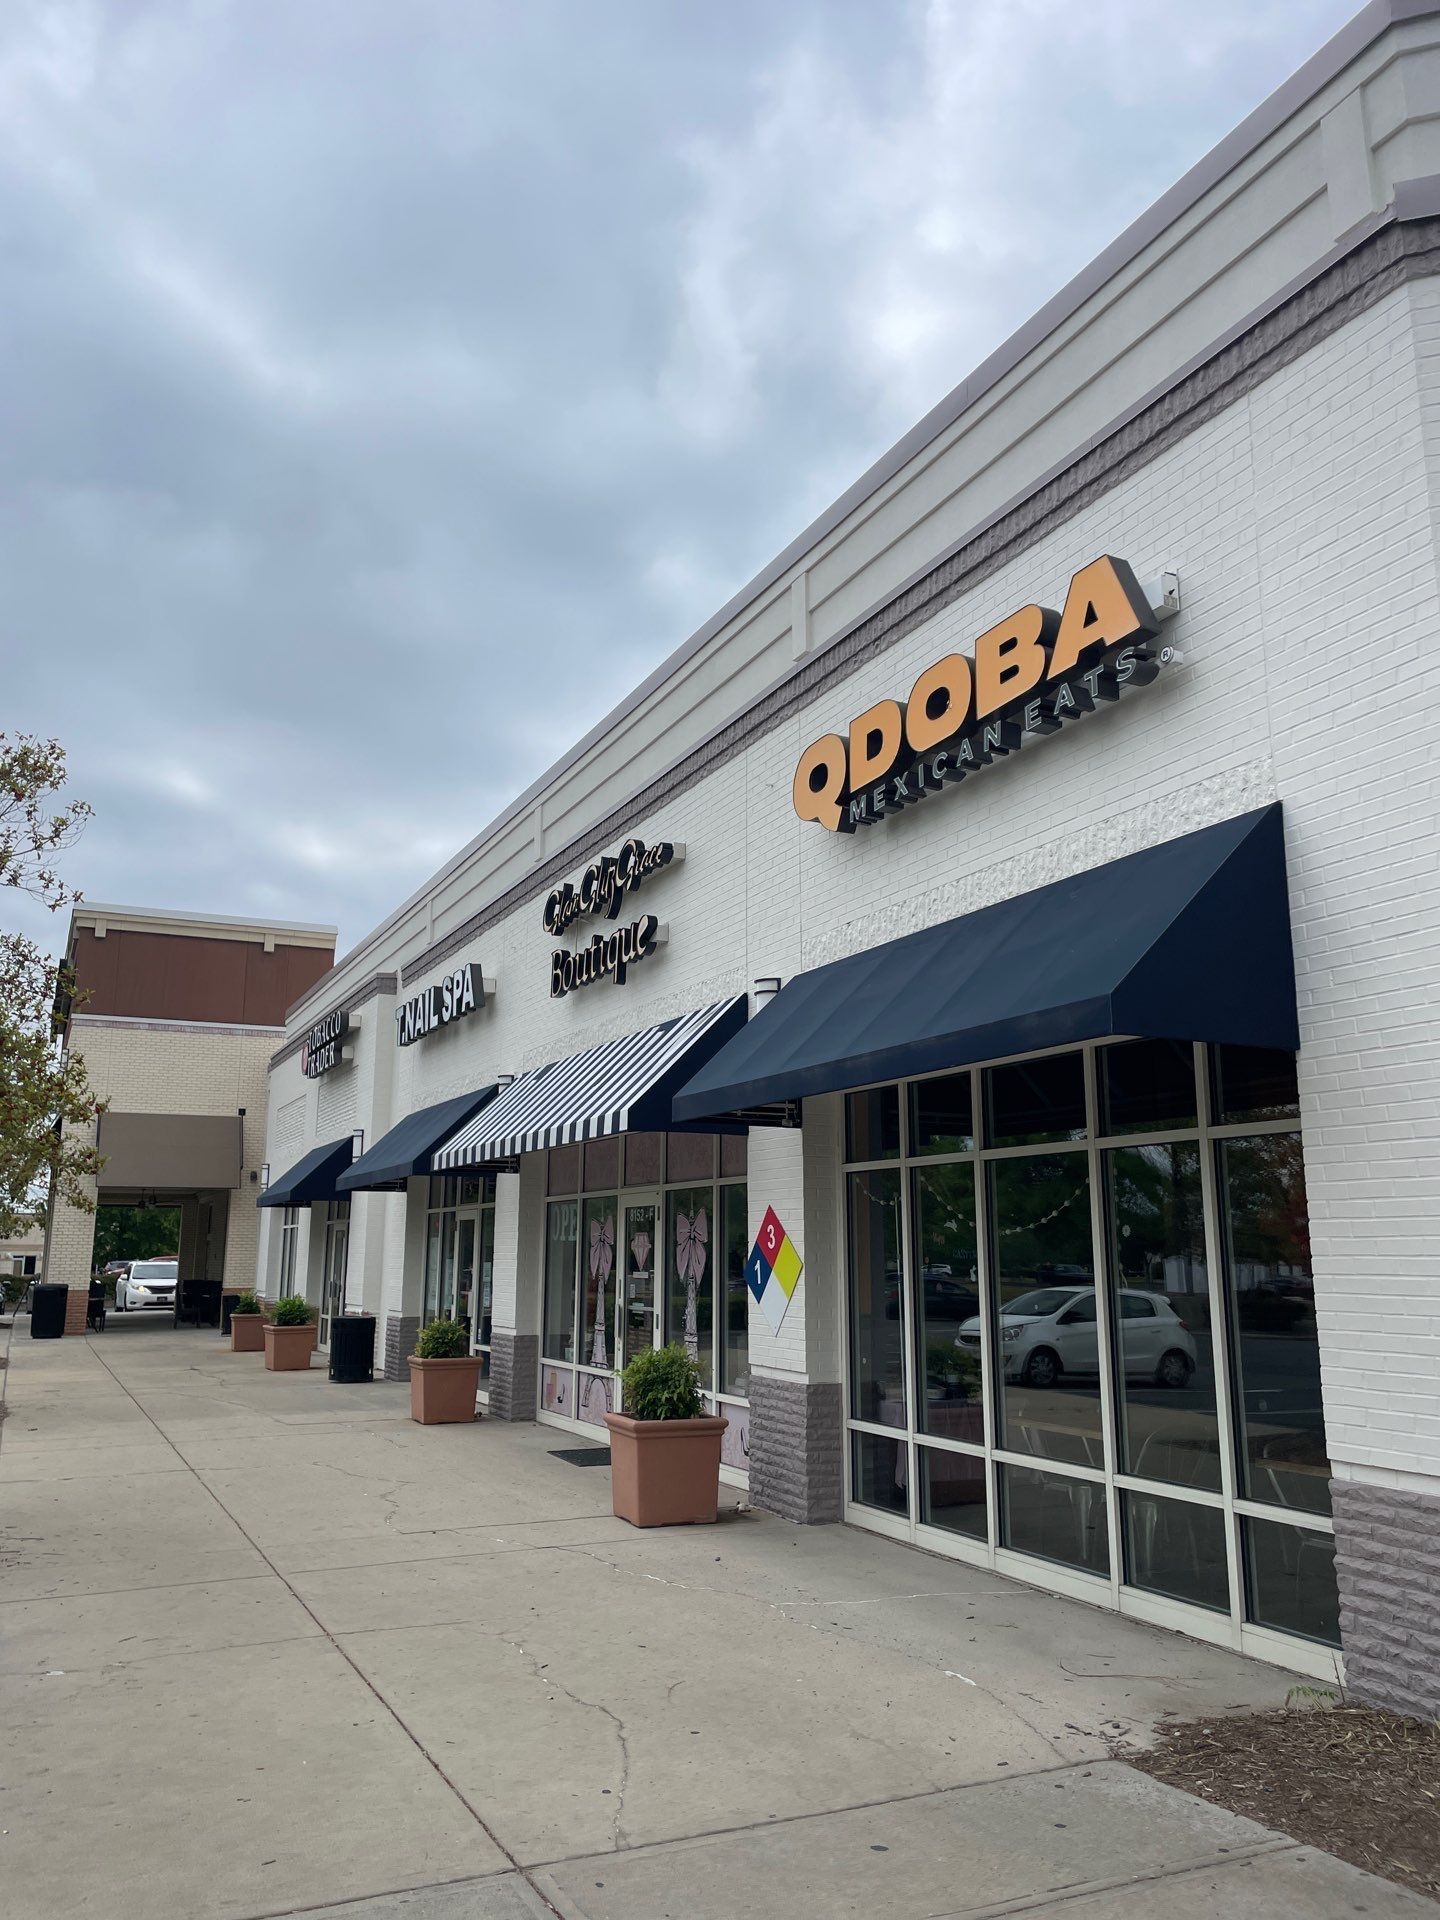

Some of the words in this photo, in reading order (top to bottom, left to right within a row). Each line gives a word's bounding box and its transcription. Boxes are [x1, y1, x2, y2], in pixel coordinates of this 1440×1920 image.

[793, 554, 1144, 832] QDOBA
[849, 720, 1004, 825] MEXICAN
[551, 915, 651, 998] Boutique
[442, 963, 476, 1022] SPA
[307, 1010, 342, 1053] TOBACCO
[307, 1041, 335, 1079] TRADER
[766, 1223, 776, 1250] 3
[754, 1259, 762, 1285] 1
